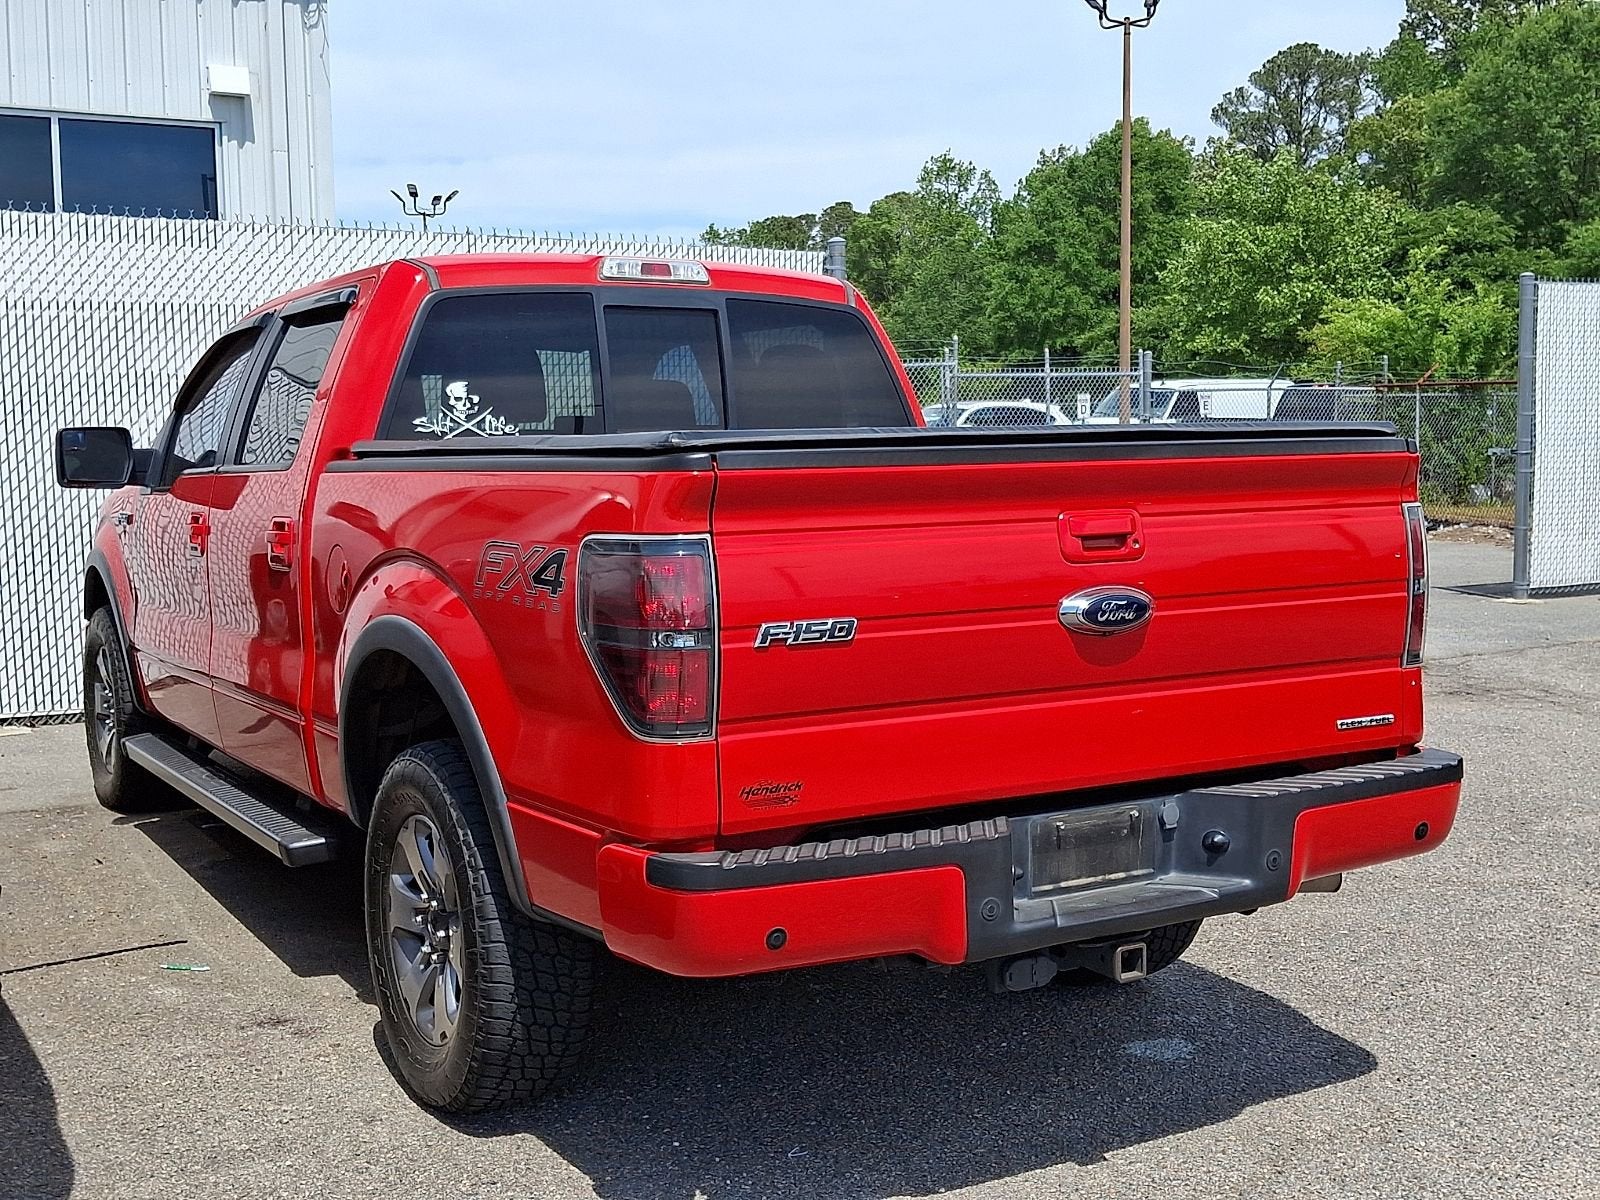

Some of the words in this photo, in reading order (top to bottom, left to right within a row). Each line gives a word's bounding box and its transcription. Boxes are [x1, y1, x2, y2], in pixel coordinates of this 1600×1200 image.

[1080, 404, 1087, 415] D
[474, 540, 569, 599] FX4
[1097, 600, 1138, 622] Ford
[753, 617, 858, 648] F-150
[1338, 719, 1363, 729] FLEX
[1370, 715, 1395, 725] FUEL
[738, 780, 804, 801] Hendrick
